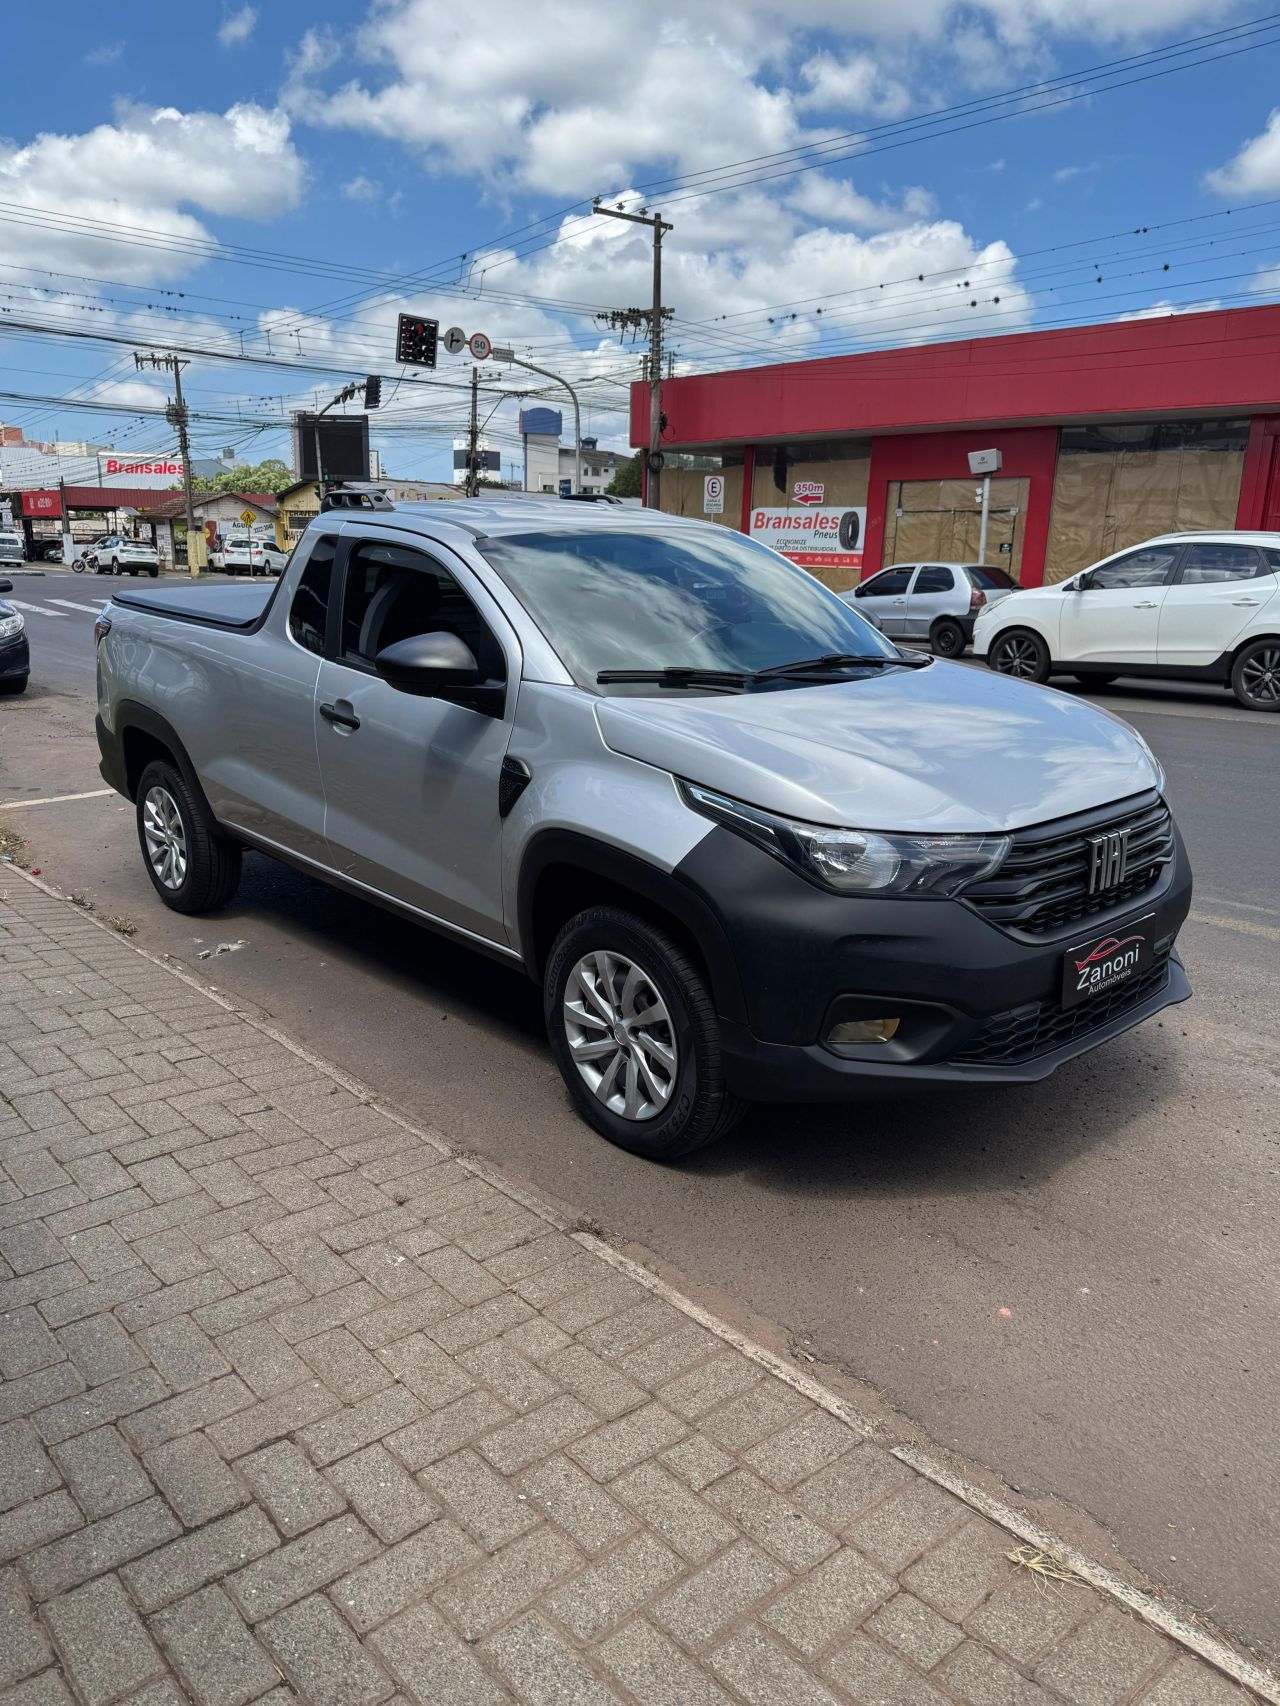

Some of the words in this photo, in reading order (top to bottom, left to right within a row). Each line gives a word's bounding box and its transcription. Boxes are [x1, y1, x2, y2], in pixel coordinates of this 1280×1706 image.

[474, 340, 485, 350] 50
[106, 458, 185, 475] Bransales
[711, 481, 718, 494] E
[795, 483, 824, 493] 350m
[753, 511, 840, 530] Bransales
[776, 538, 807, 546] ECONOMIZE
[813, 530, 838, 539] Pneus
[1088, 828, 1131, 895] FIAT
[1077, 943, 1139, 990] Zanoni
[1088, 968, 1132, 995] Automóveis
